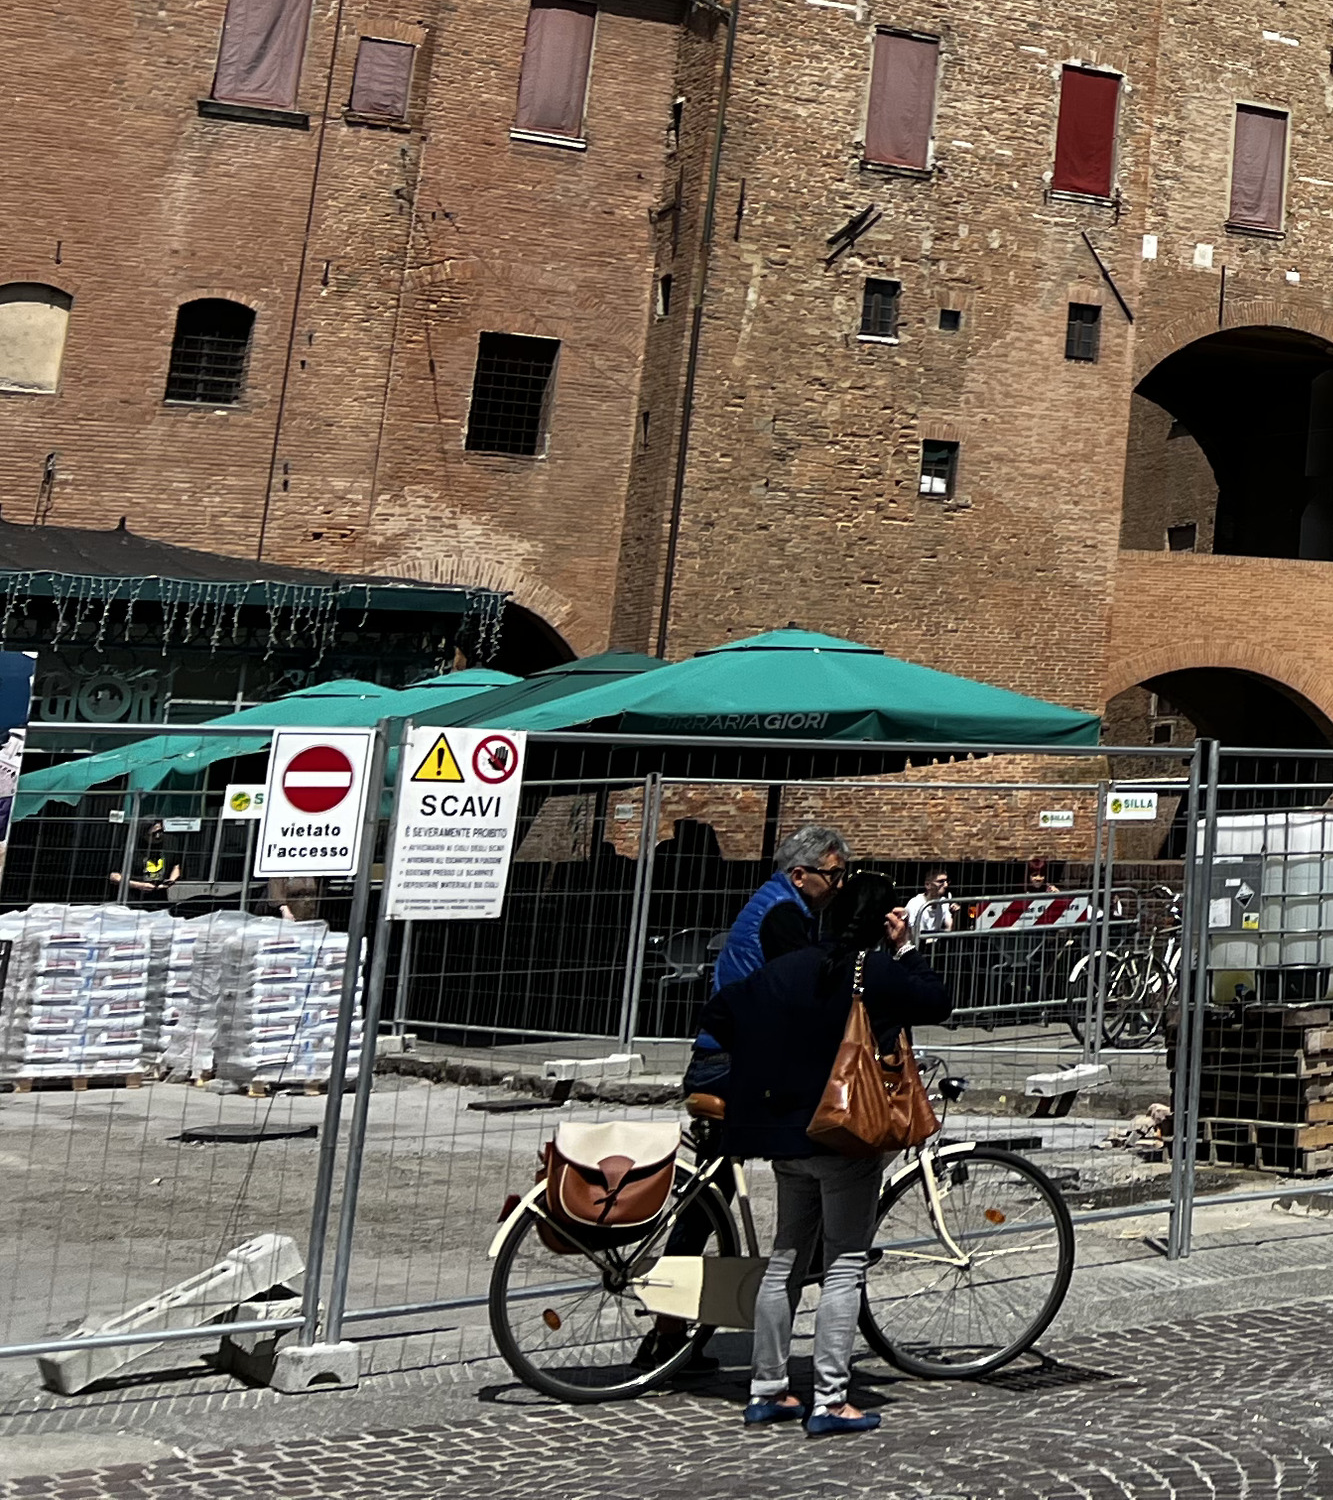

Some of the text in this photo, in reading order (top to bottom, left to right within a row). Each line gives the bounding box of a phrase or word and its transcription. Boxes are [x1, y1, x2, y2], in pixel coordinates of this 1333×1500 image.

[763, 713, 829, 730] GIORI
[420, 795, 501, 817] SCAVI
[1124, 799, 1153, 808] SILLA
[281, 823, 341, 837] vietato
[412, 827, 471, 838] SEVERAMENTE
[472, 828, 507, 838] PROIBITO
[267, 844, 349, 858] l'accesso
